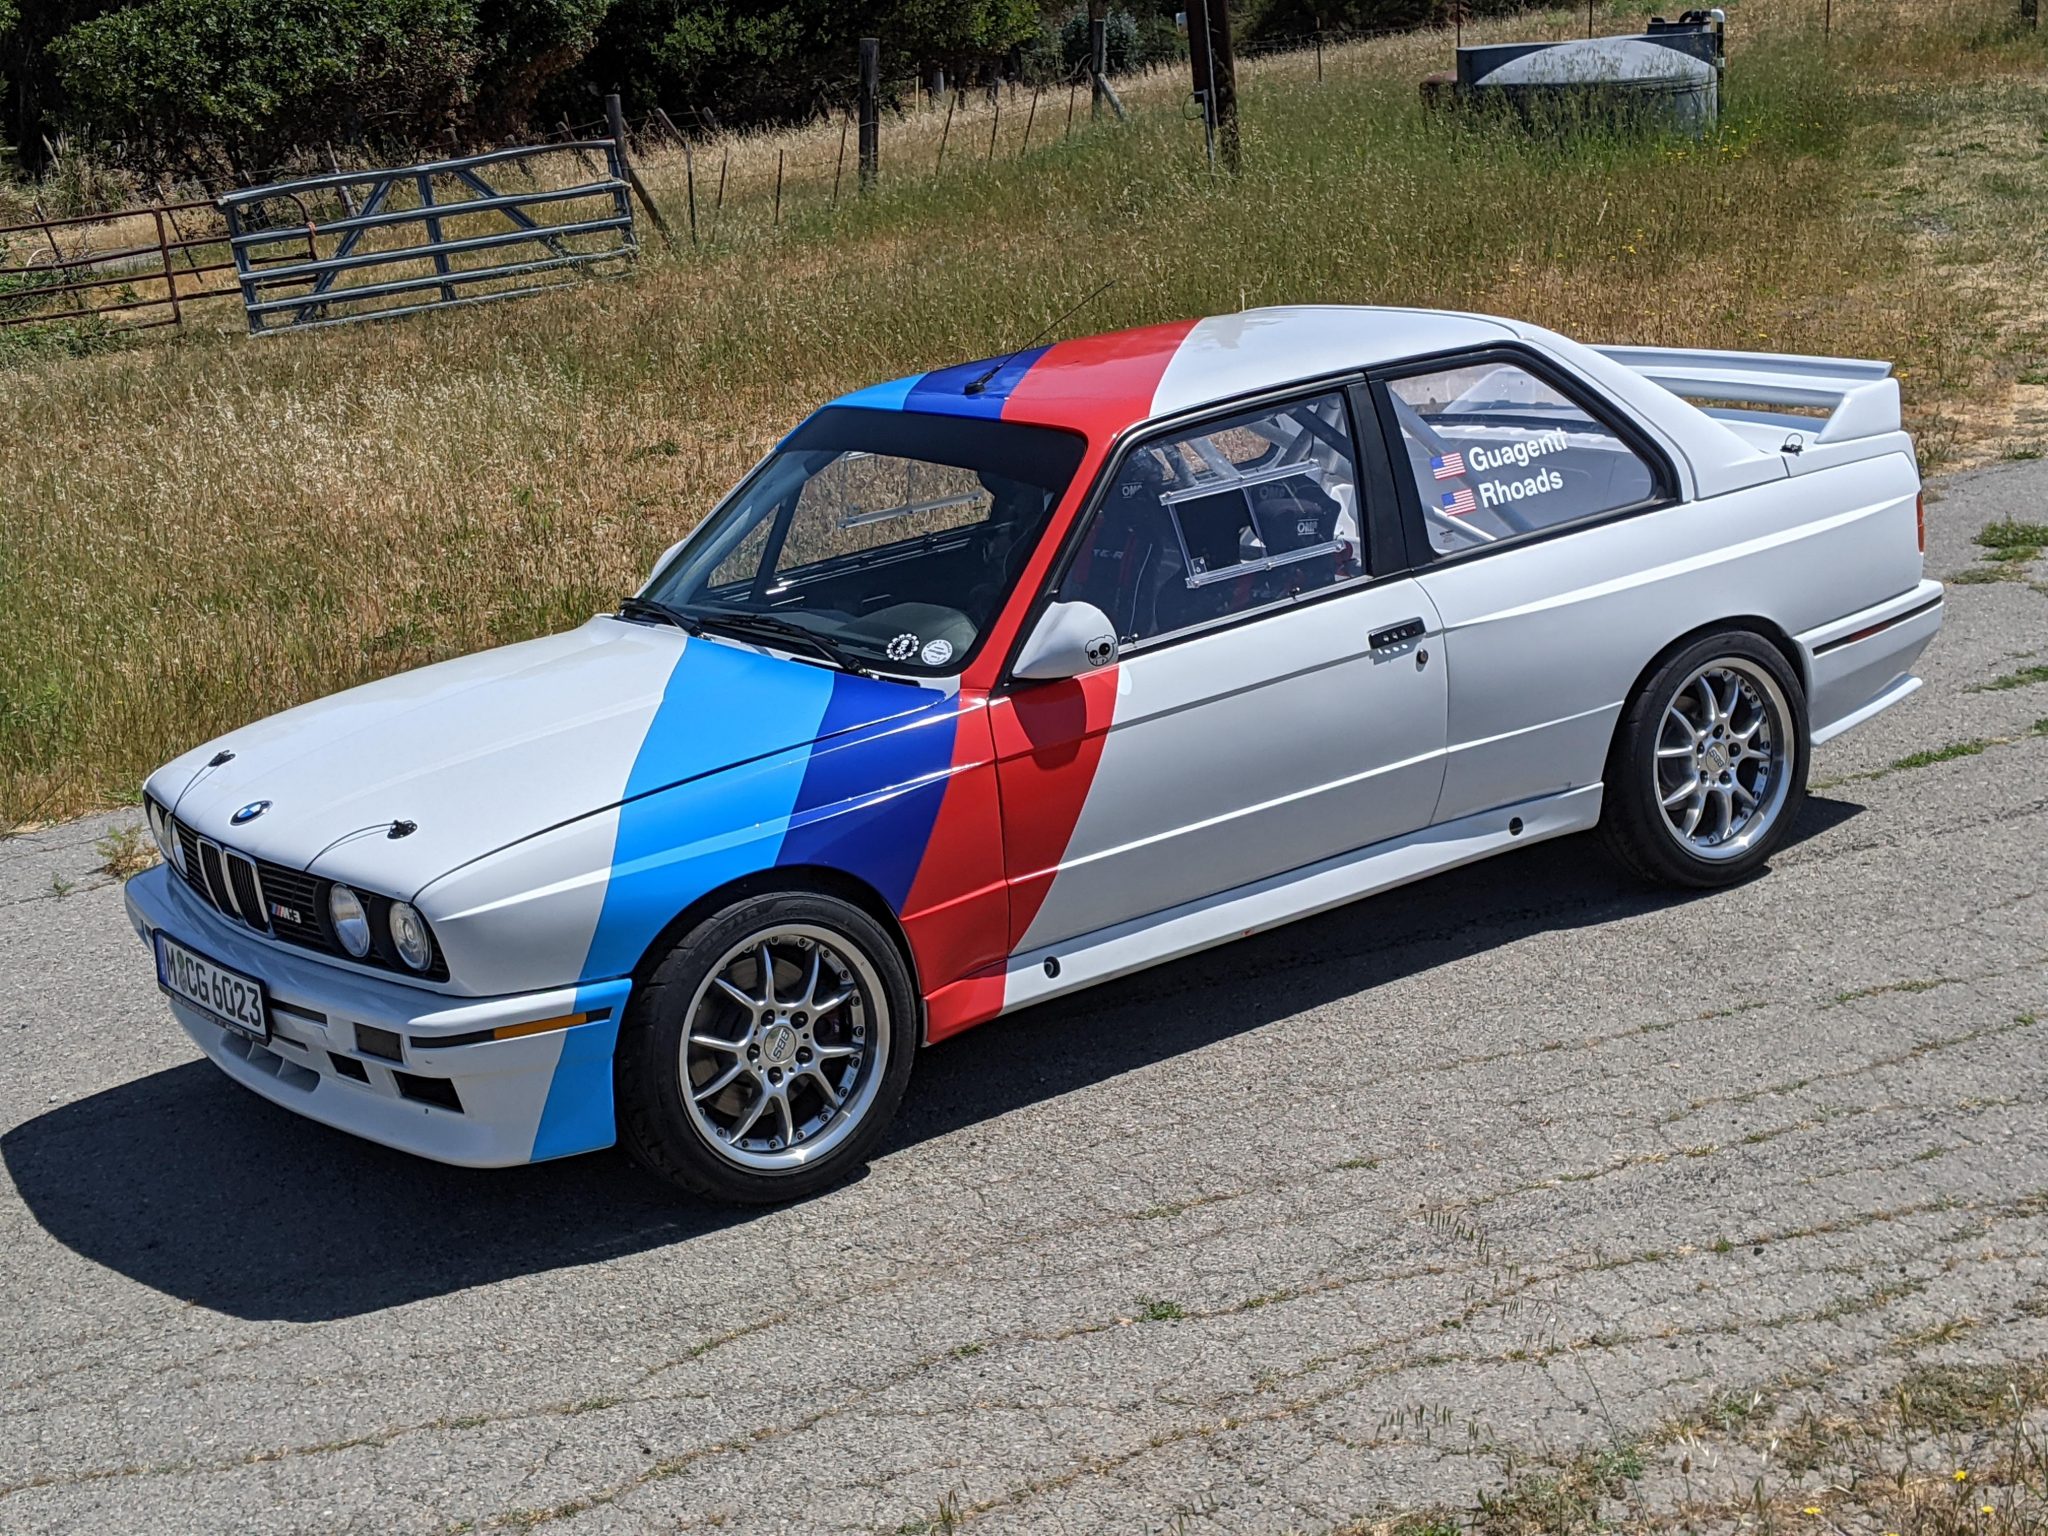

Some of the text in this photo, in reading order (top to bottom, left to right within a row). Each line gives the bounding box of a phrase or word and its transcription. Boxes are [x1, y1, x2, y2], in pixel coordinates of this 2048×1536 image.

[1468, 427, 1569, 471] Guagenti
[1478, 467, 1563, 508] Rhoads
[212, 971, 262, 1027] 6023
[772, 1028, 790, 1060] BBS
